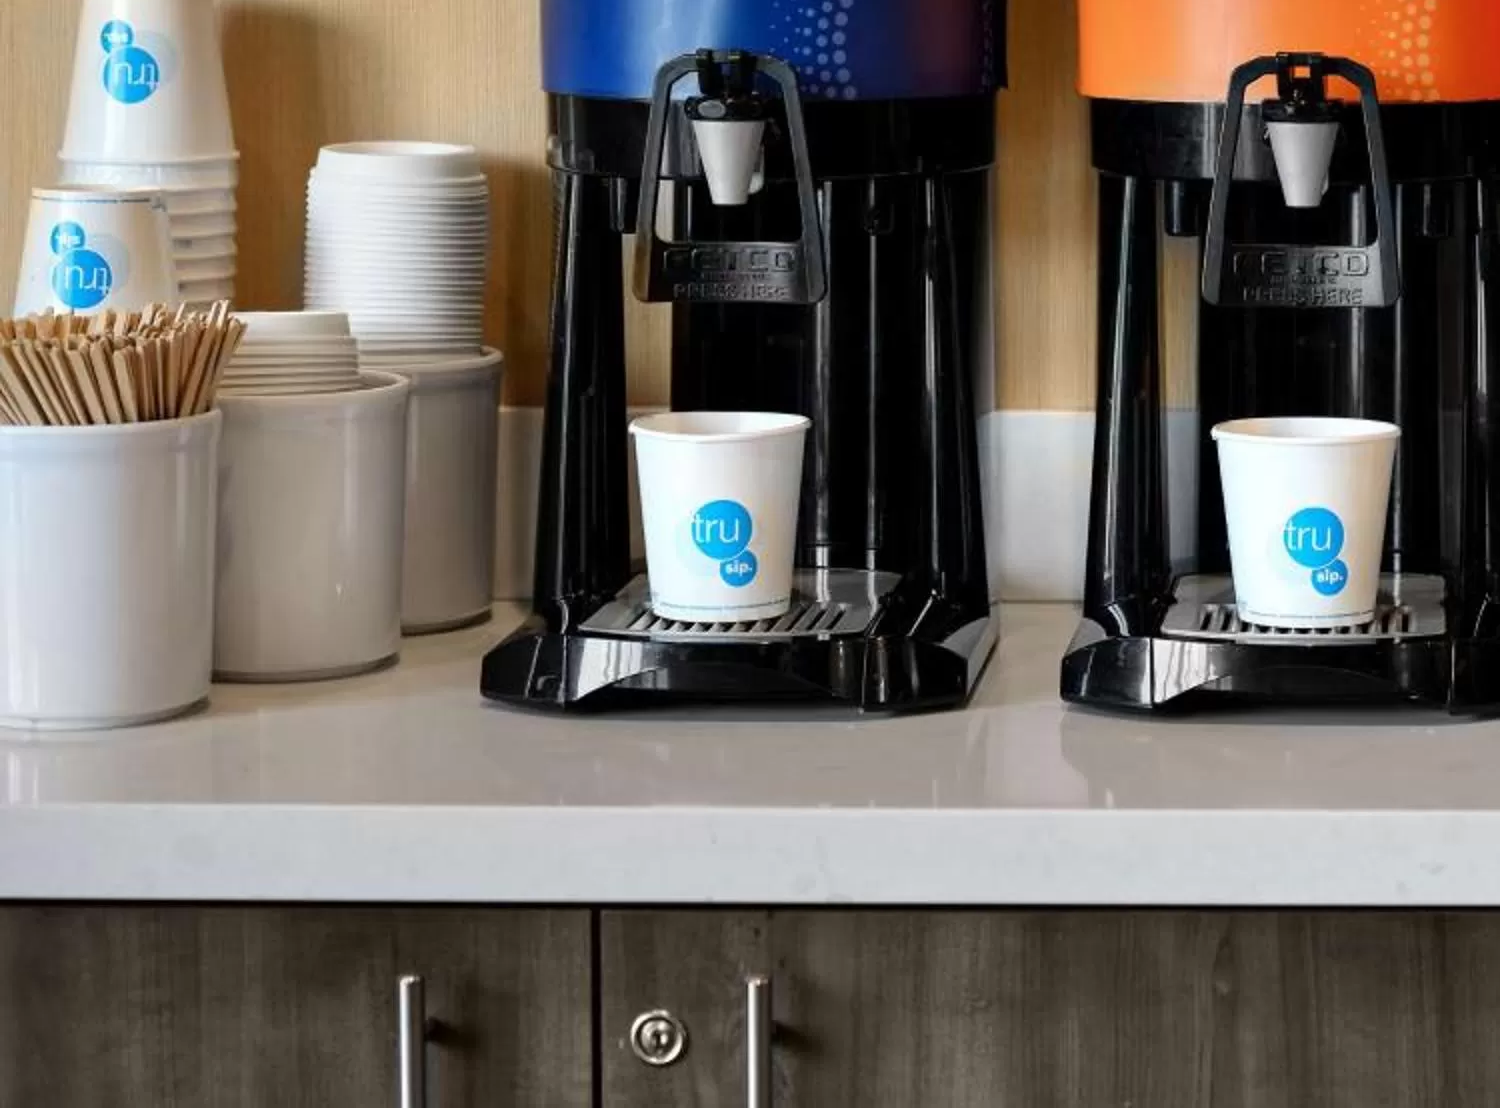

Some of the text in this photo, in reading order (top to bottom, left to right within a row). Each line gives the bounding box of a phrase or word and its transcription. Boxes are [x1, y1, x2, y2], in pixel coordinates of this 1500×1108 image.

[65, 266, 110, 295] tru
[692, 512, 739, 544] tru
[1284, 520, 1331, 552] tru
